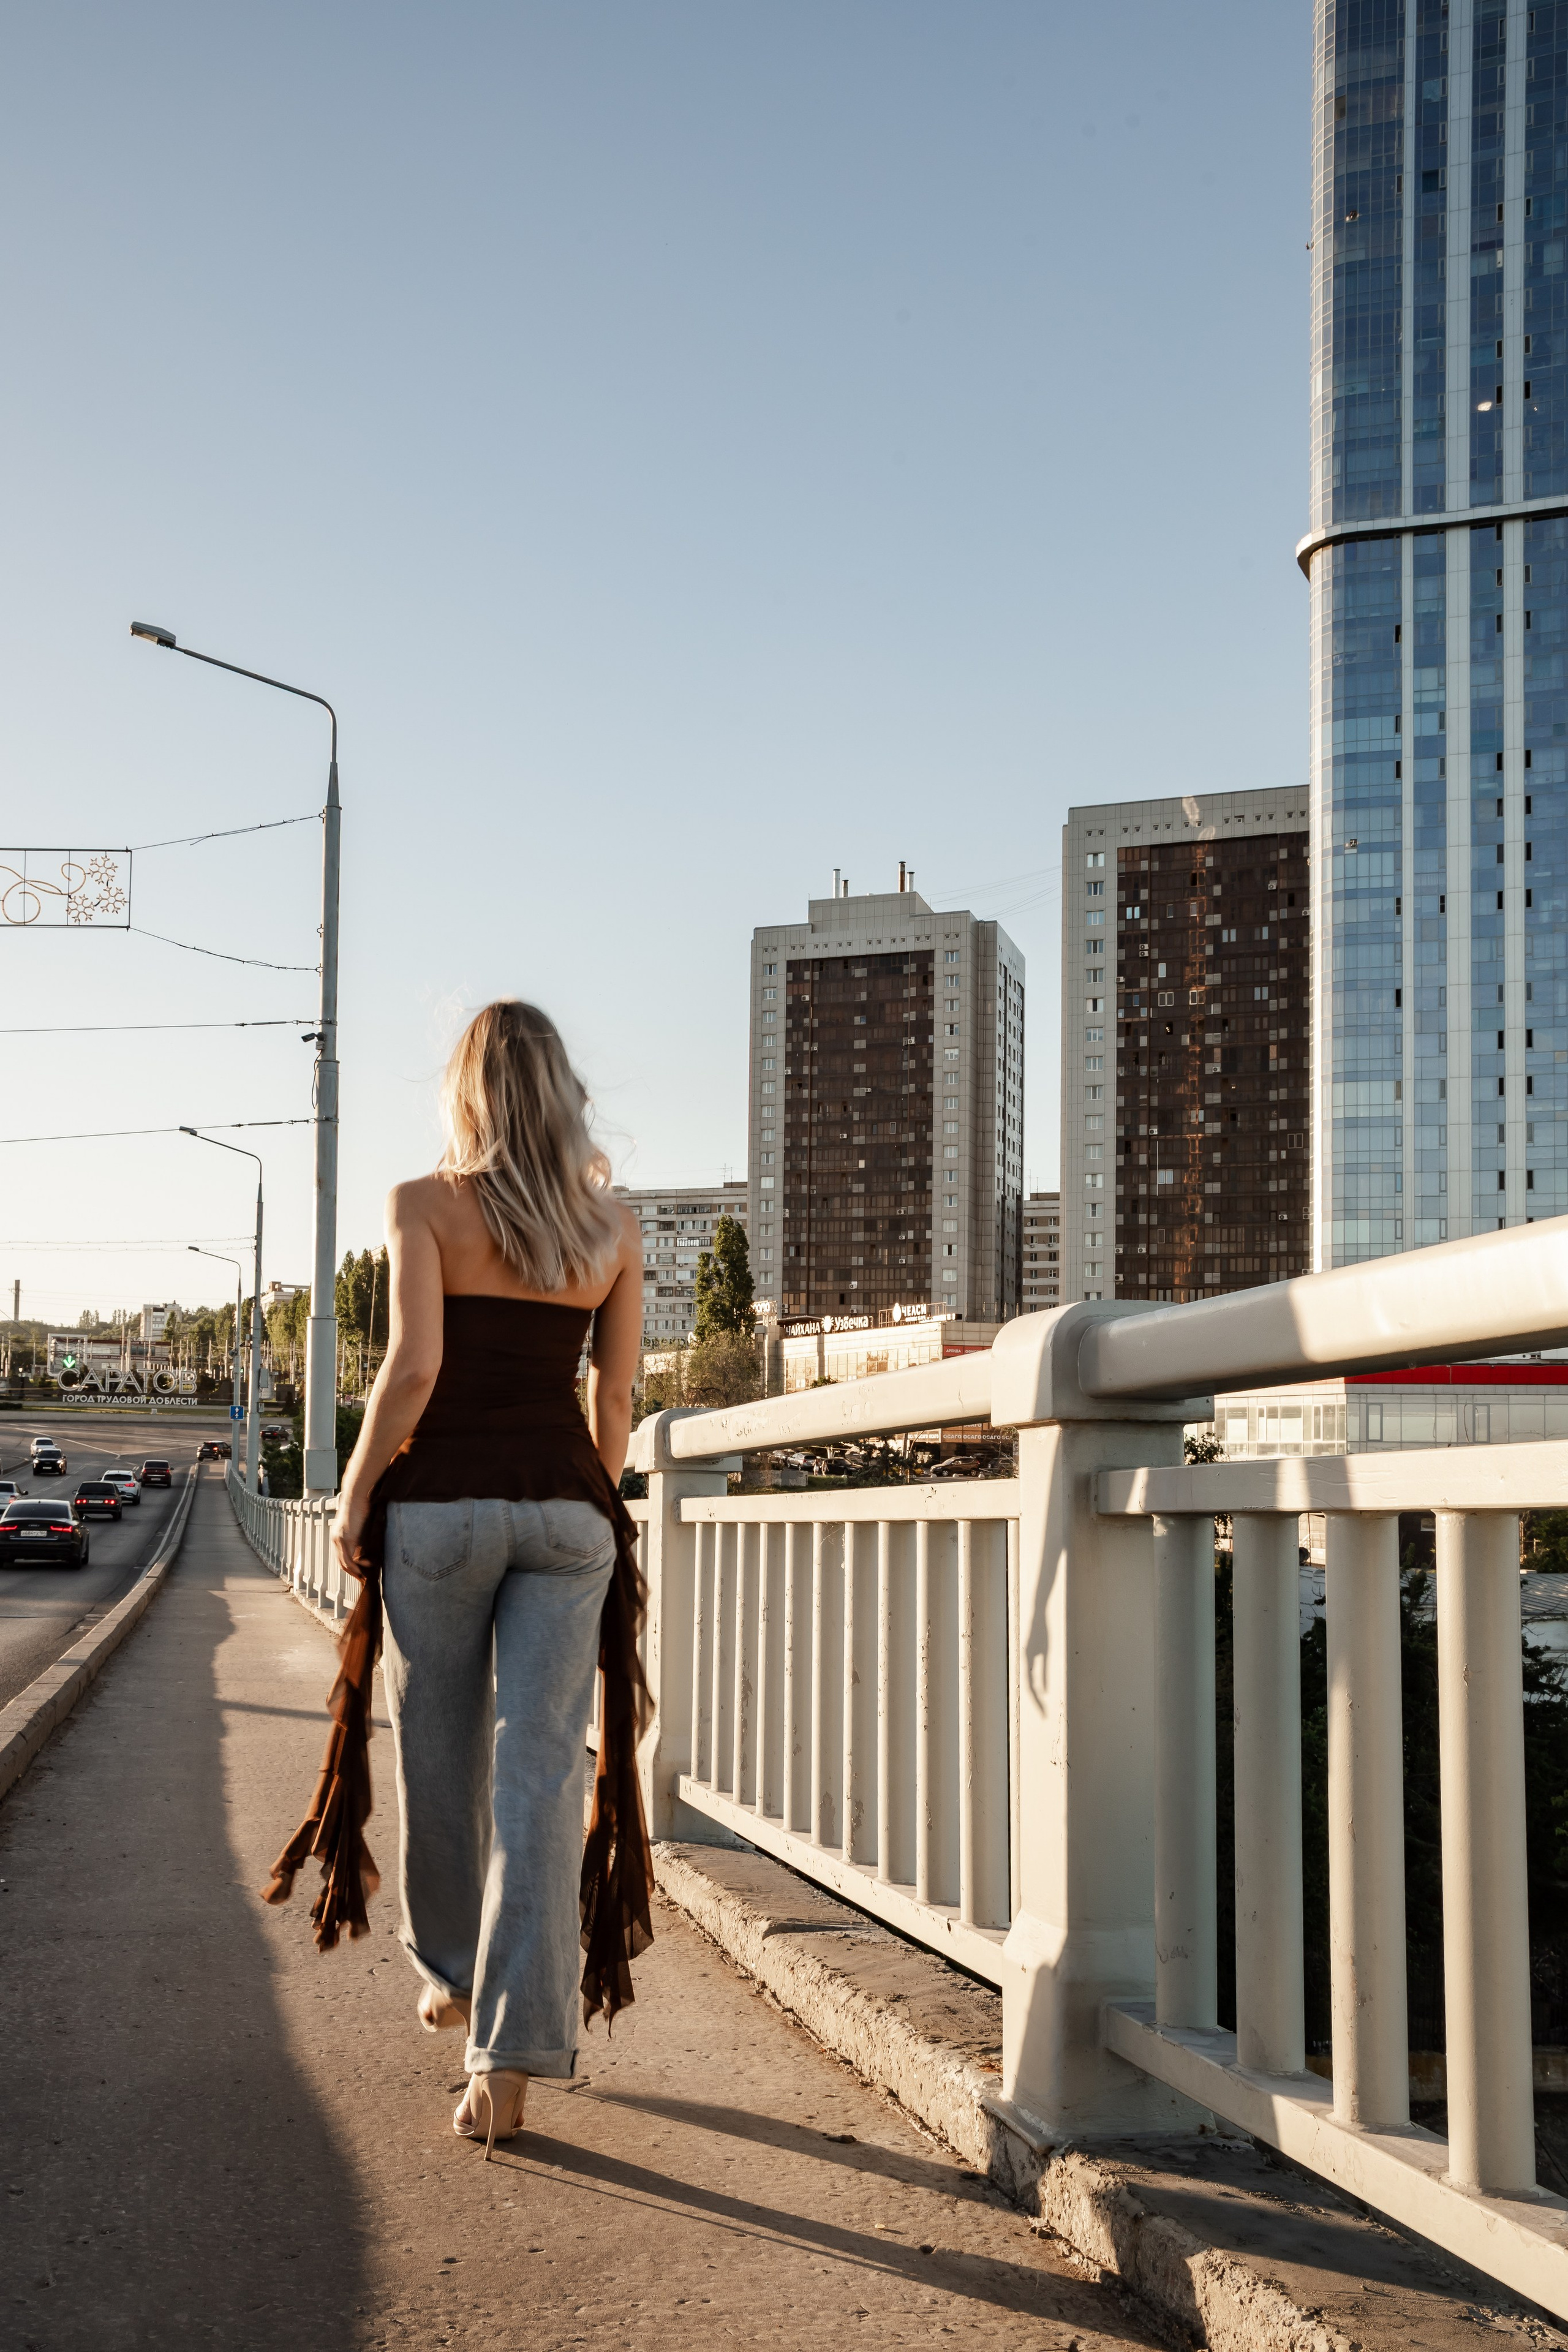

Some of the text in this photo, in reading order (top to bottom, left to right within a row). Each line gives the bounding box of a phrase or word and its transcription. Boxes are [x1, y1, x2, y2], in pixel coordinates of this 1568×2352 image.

[902, 1303, 927, 1316] ЧЕЛСИ
[786, 1316, 869, 1336] ЧАЙХАНА Узбечка
[58, 1368, 197, 1395] САРАТОВ
[62, 1395, 198, 1406] ГОРОД ТРУДОВОЙ ДОБЛЕСТИ
